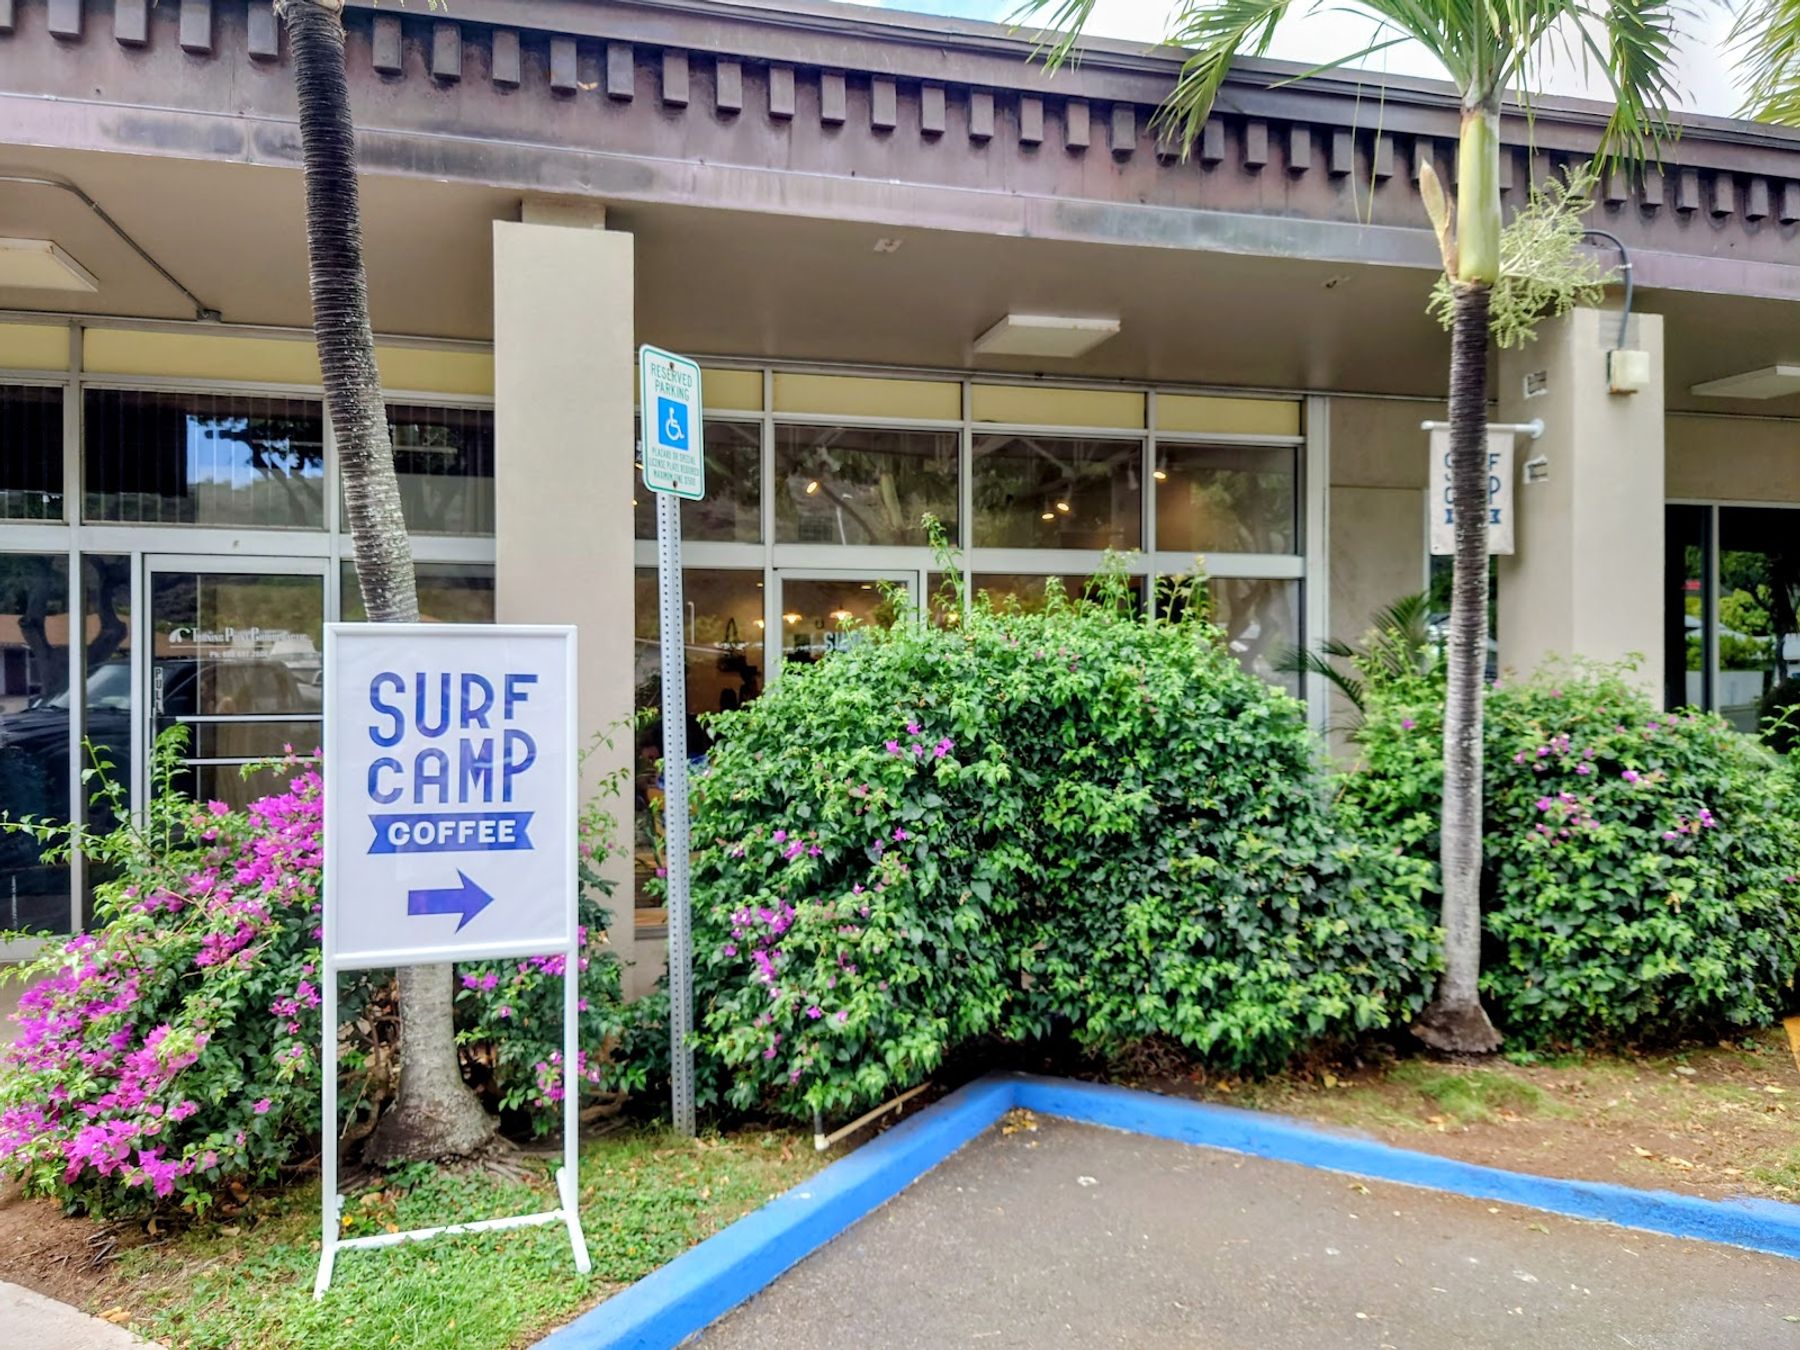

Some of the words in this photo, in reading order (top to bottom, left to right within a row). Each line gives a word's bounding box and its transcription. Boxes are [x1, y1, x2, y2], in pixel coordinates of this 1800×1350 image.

[651, 363, 692, 388] RESERVED
[655, 380, 690, 401] PARKING
[368, 671, 538, 747] SURF
[367, 728, 537, 805] CAMP
[387, 819, 516, 846] COFFEE
